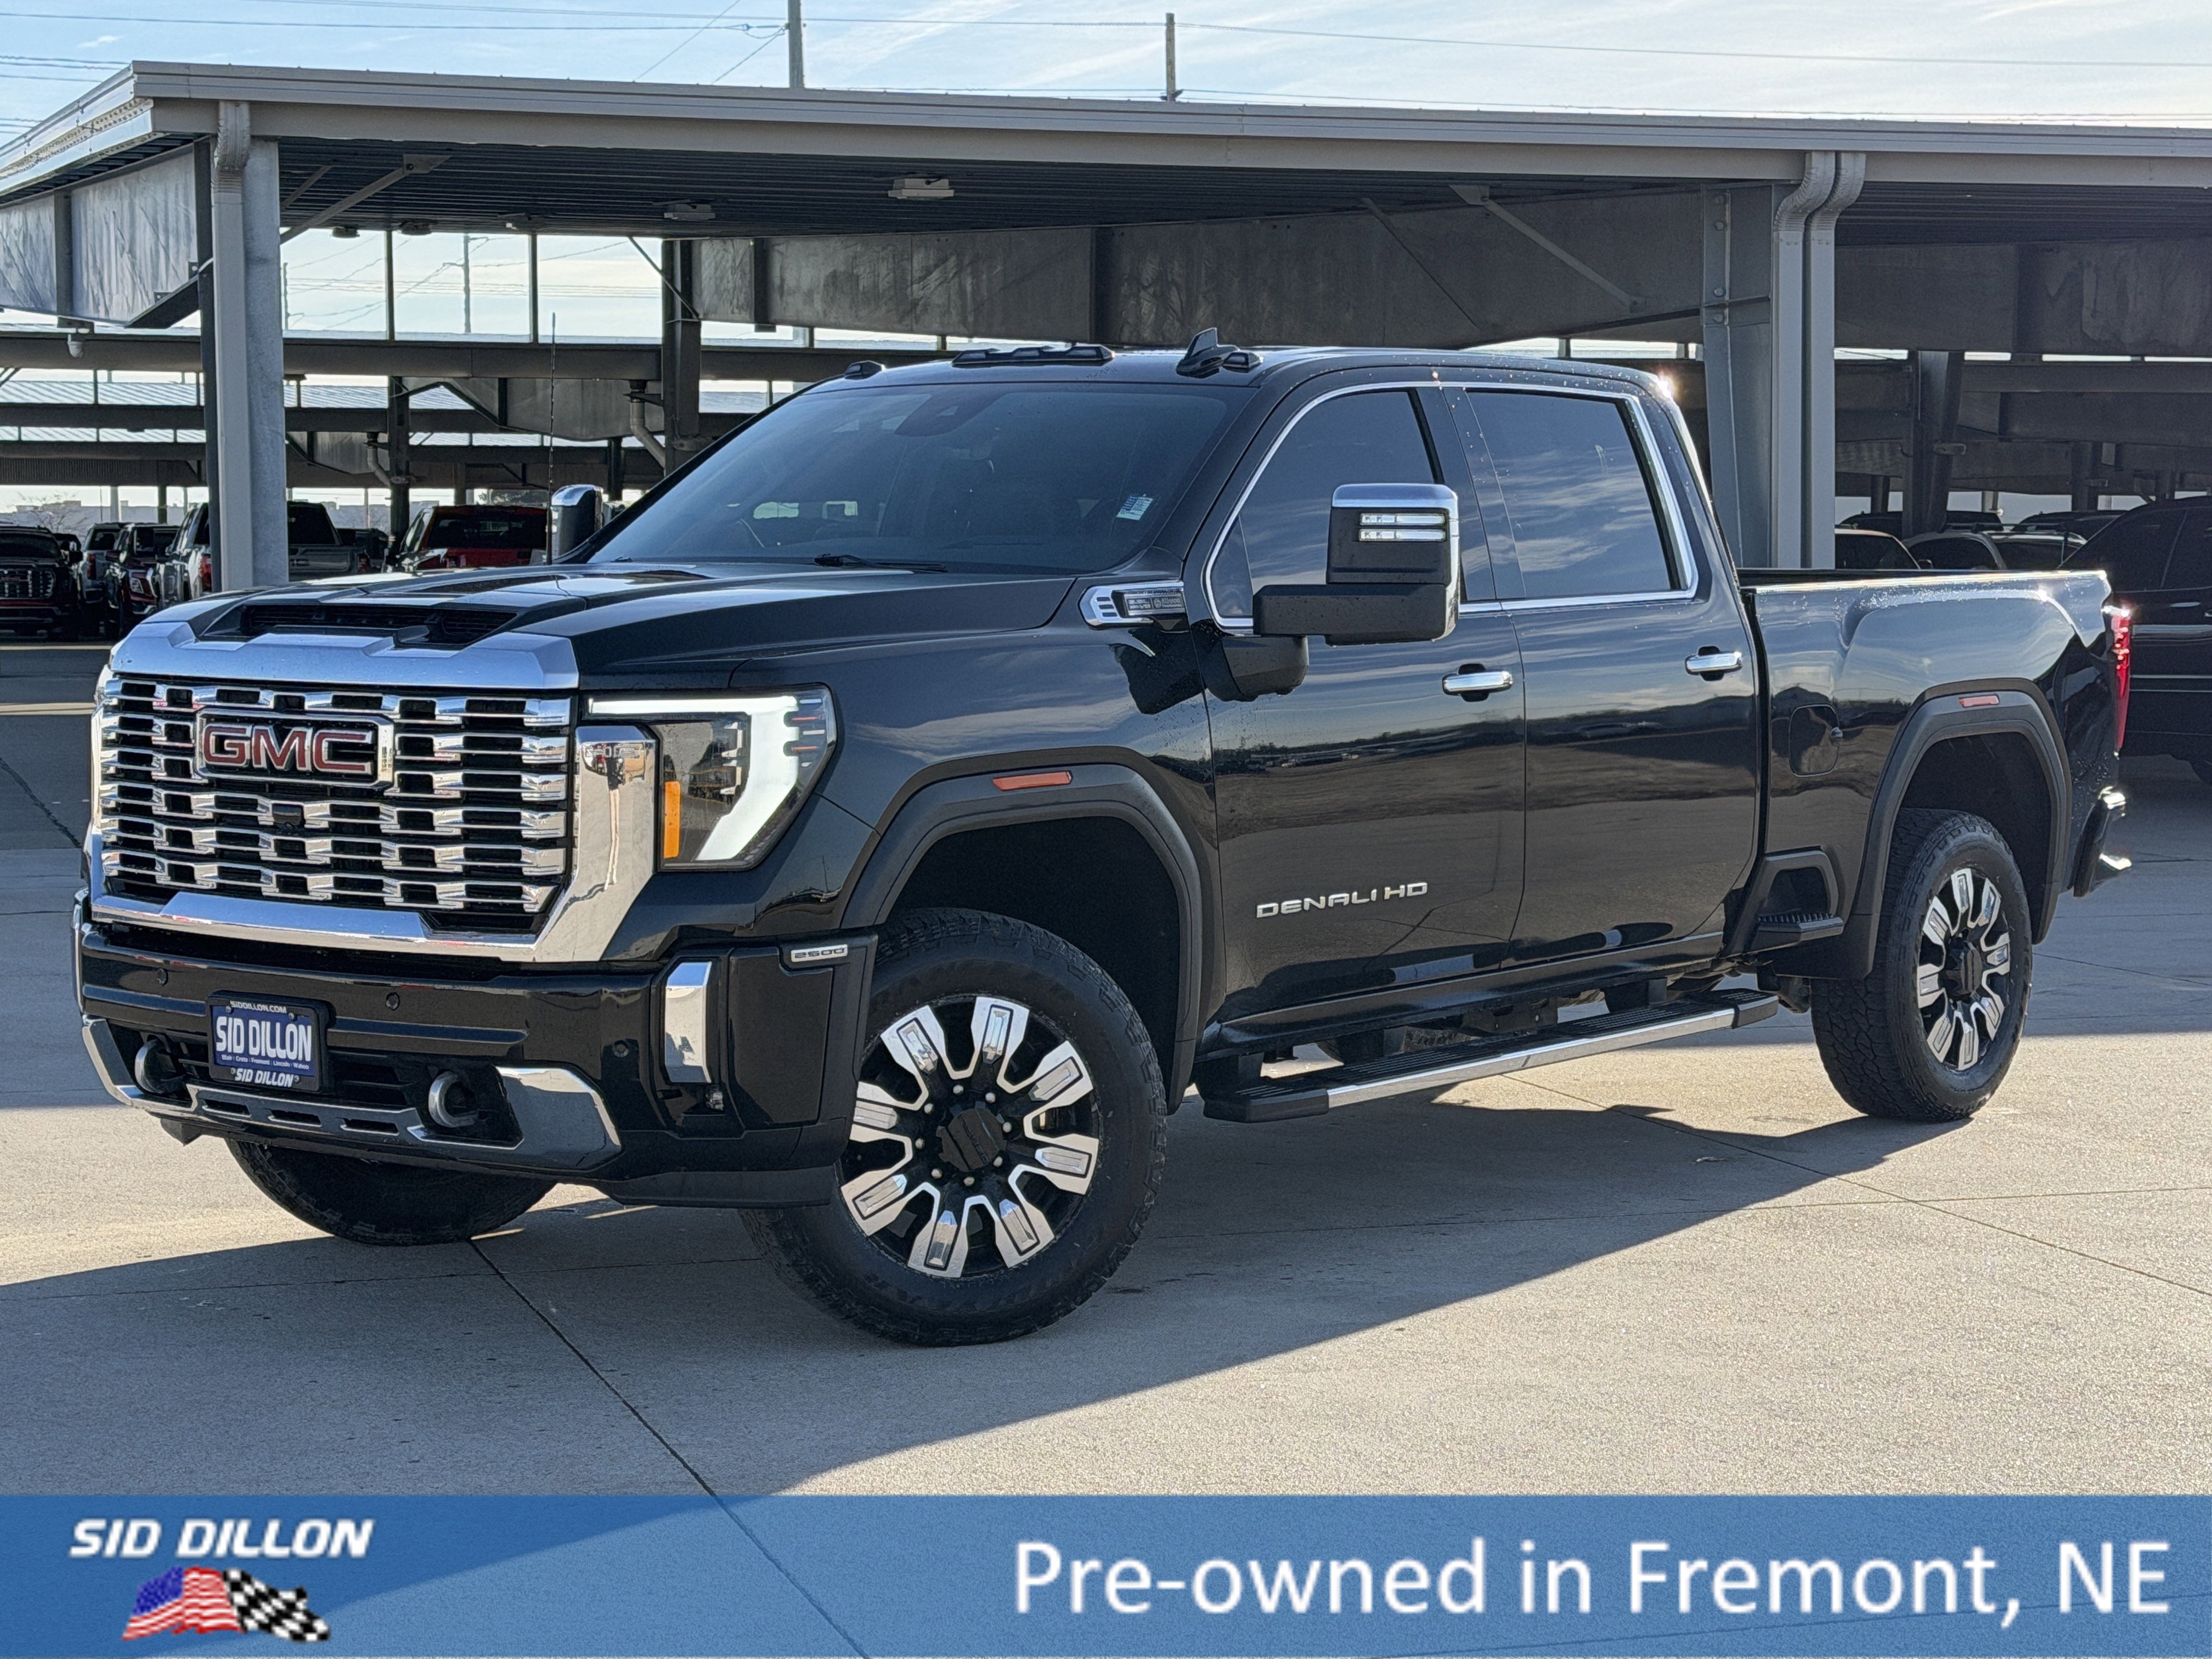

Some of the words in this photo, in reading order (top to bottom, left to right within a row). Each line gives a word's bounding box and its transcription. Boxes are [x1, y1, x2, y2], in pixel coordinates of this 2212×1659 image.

[203, 724, 373, 775] GMC
[1256, 889, 1377, 918] DENALI
[1384, 882, 1427, 900] HD
[794, 947, 845, 958] 2500
[216, 1017, 244, 1053] SID
[249, 1019, 312, 1062] DILLON
[234, 1068, 253, 1082] SID
[255, 1070, 294, 1087] DILLON
